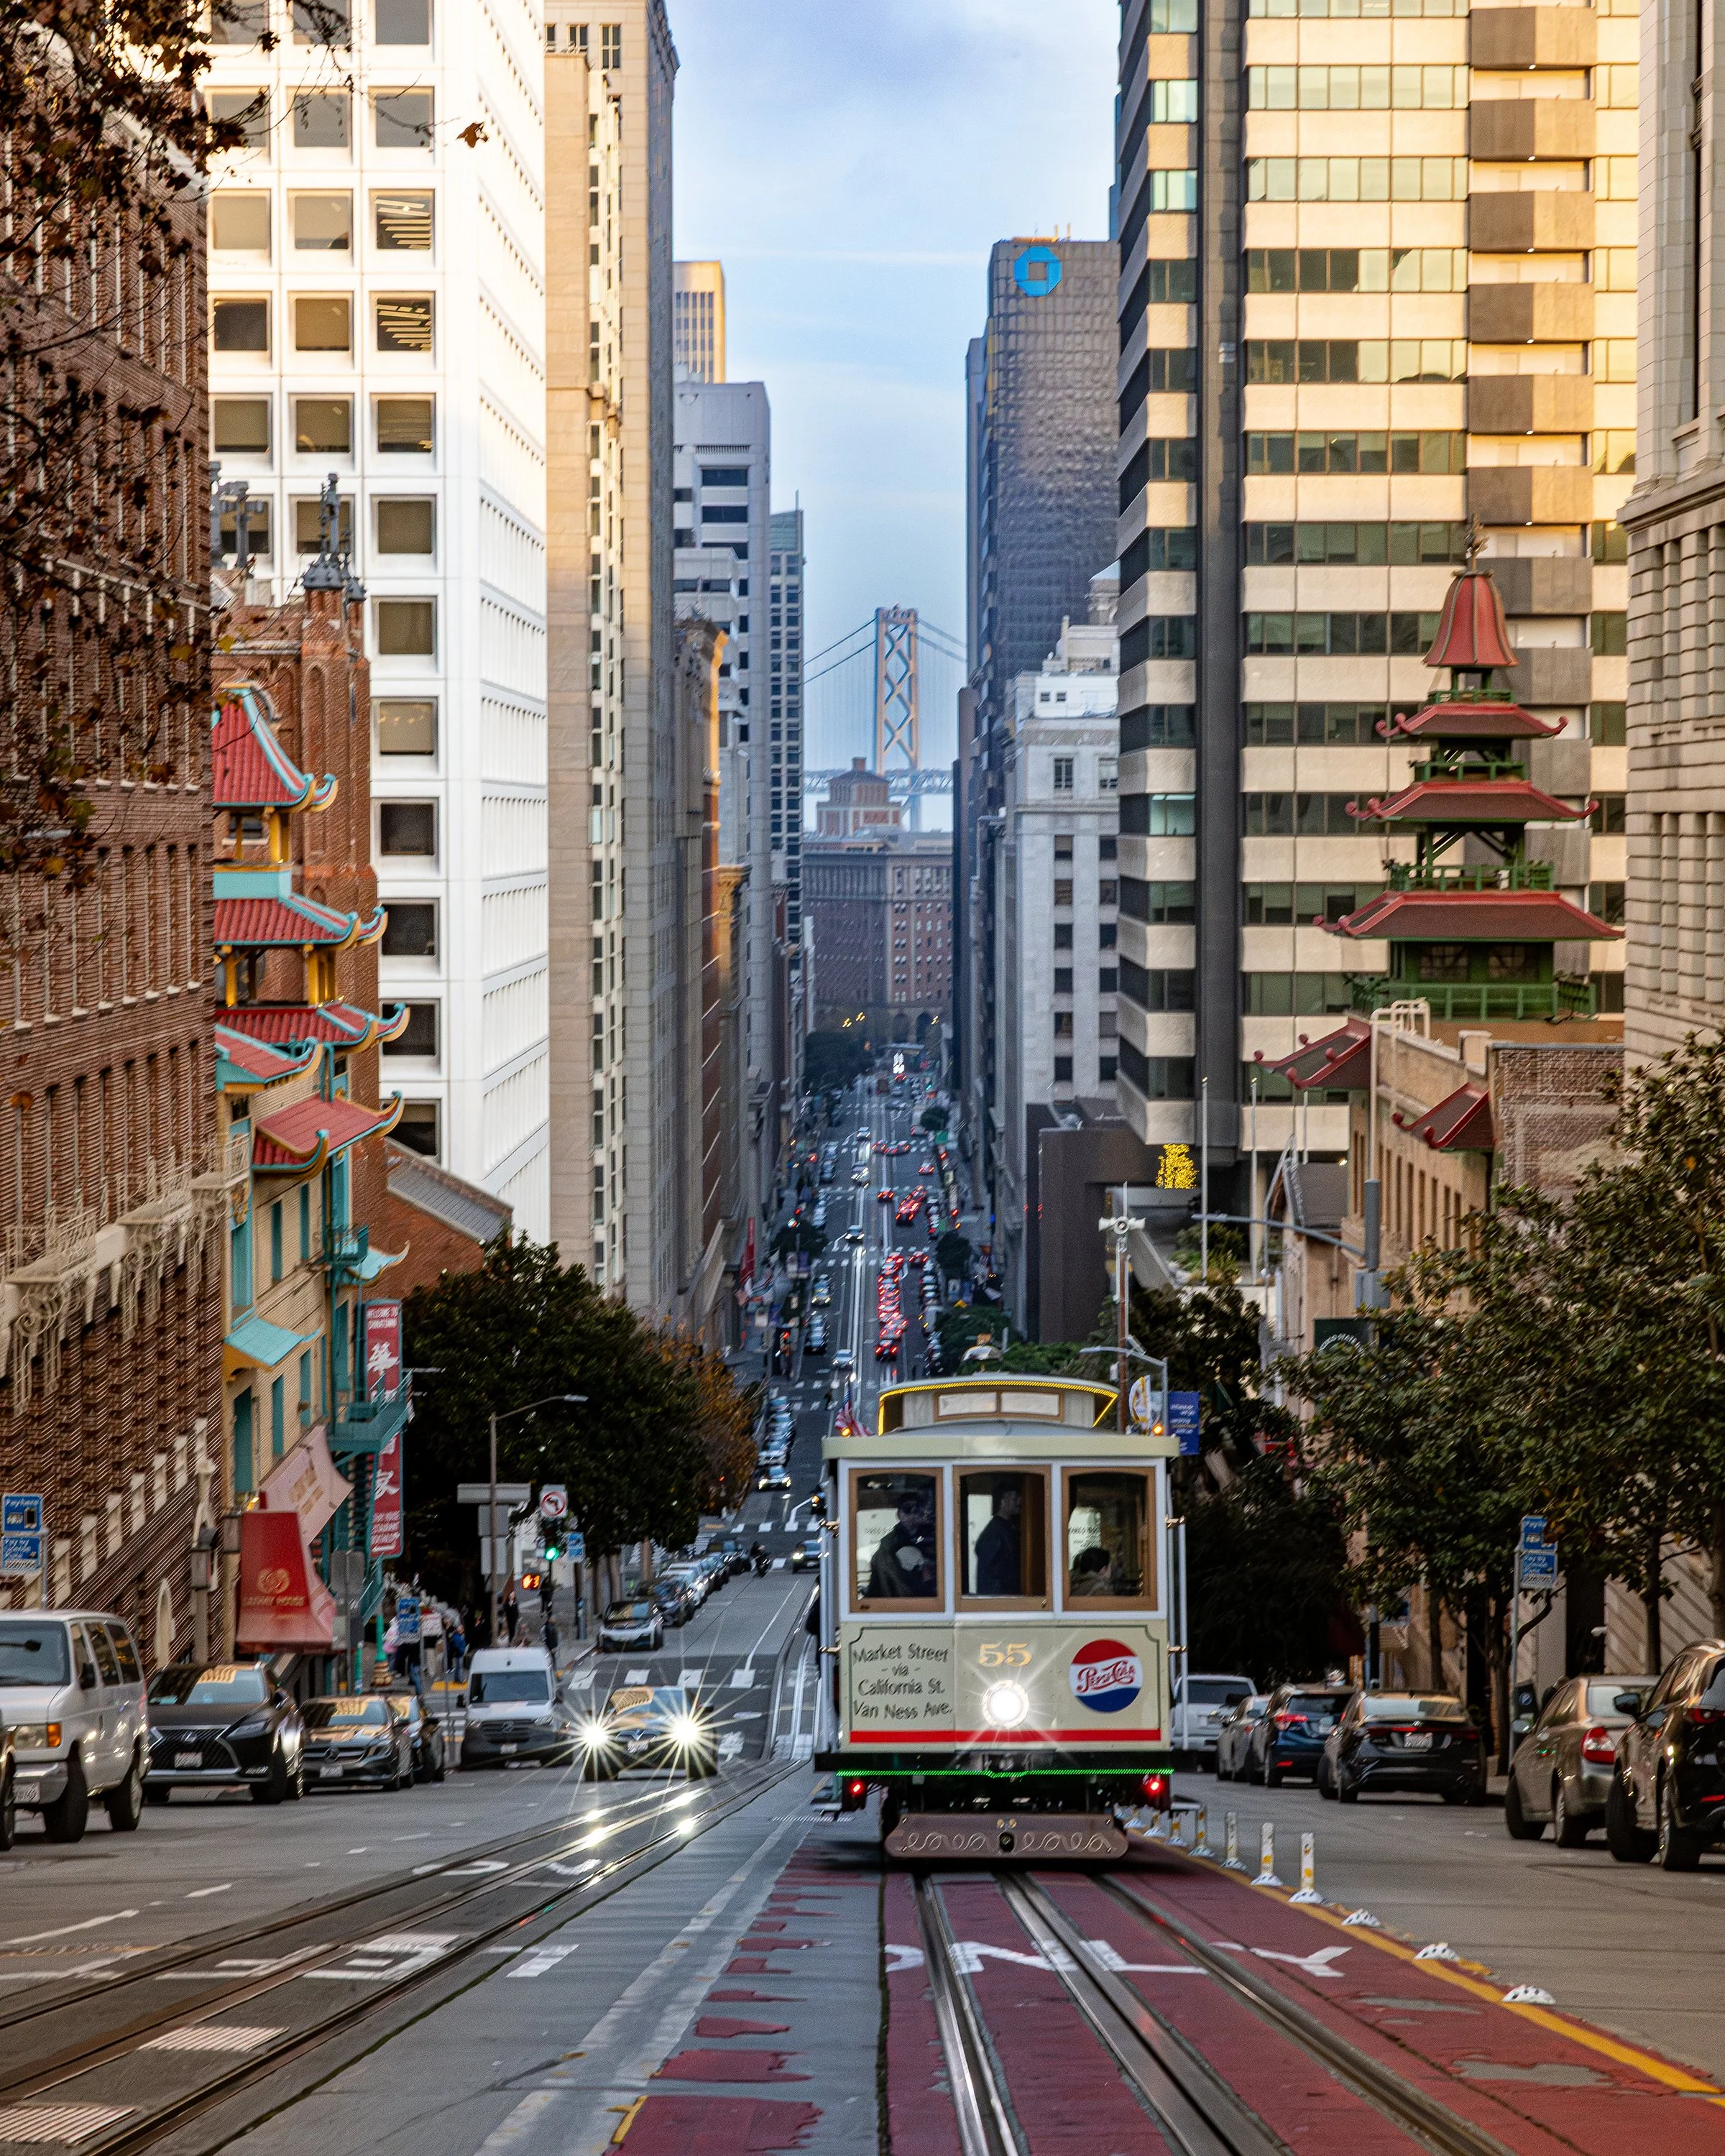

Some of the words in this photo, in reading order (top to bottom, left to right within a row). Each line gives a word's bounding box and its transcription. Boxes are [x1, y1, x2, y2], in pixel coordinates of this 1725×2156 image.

[852, 1643, 903, 1664] Market
[908, 1643, 949, 1663] Street
[978, 1643, 1033, 1667] 55
[858, 1678, 924, 1696] California
[853, 1700, 879, 1719] Van
[884, 1703, 919, 1720] Ness
[924, 1701, 953, 1718] Ave.
